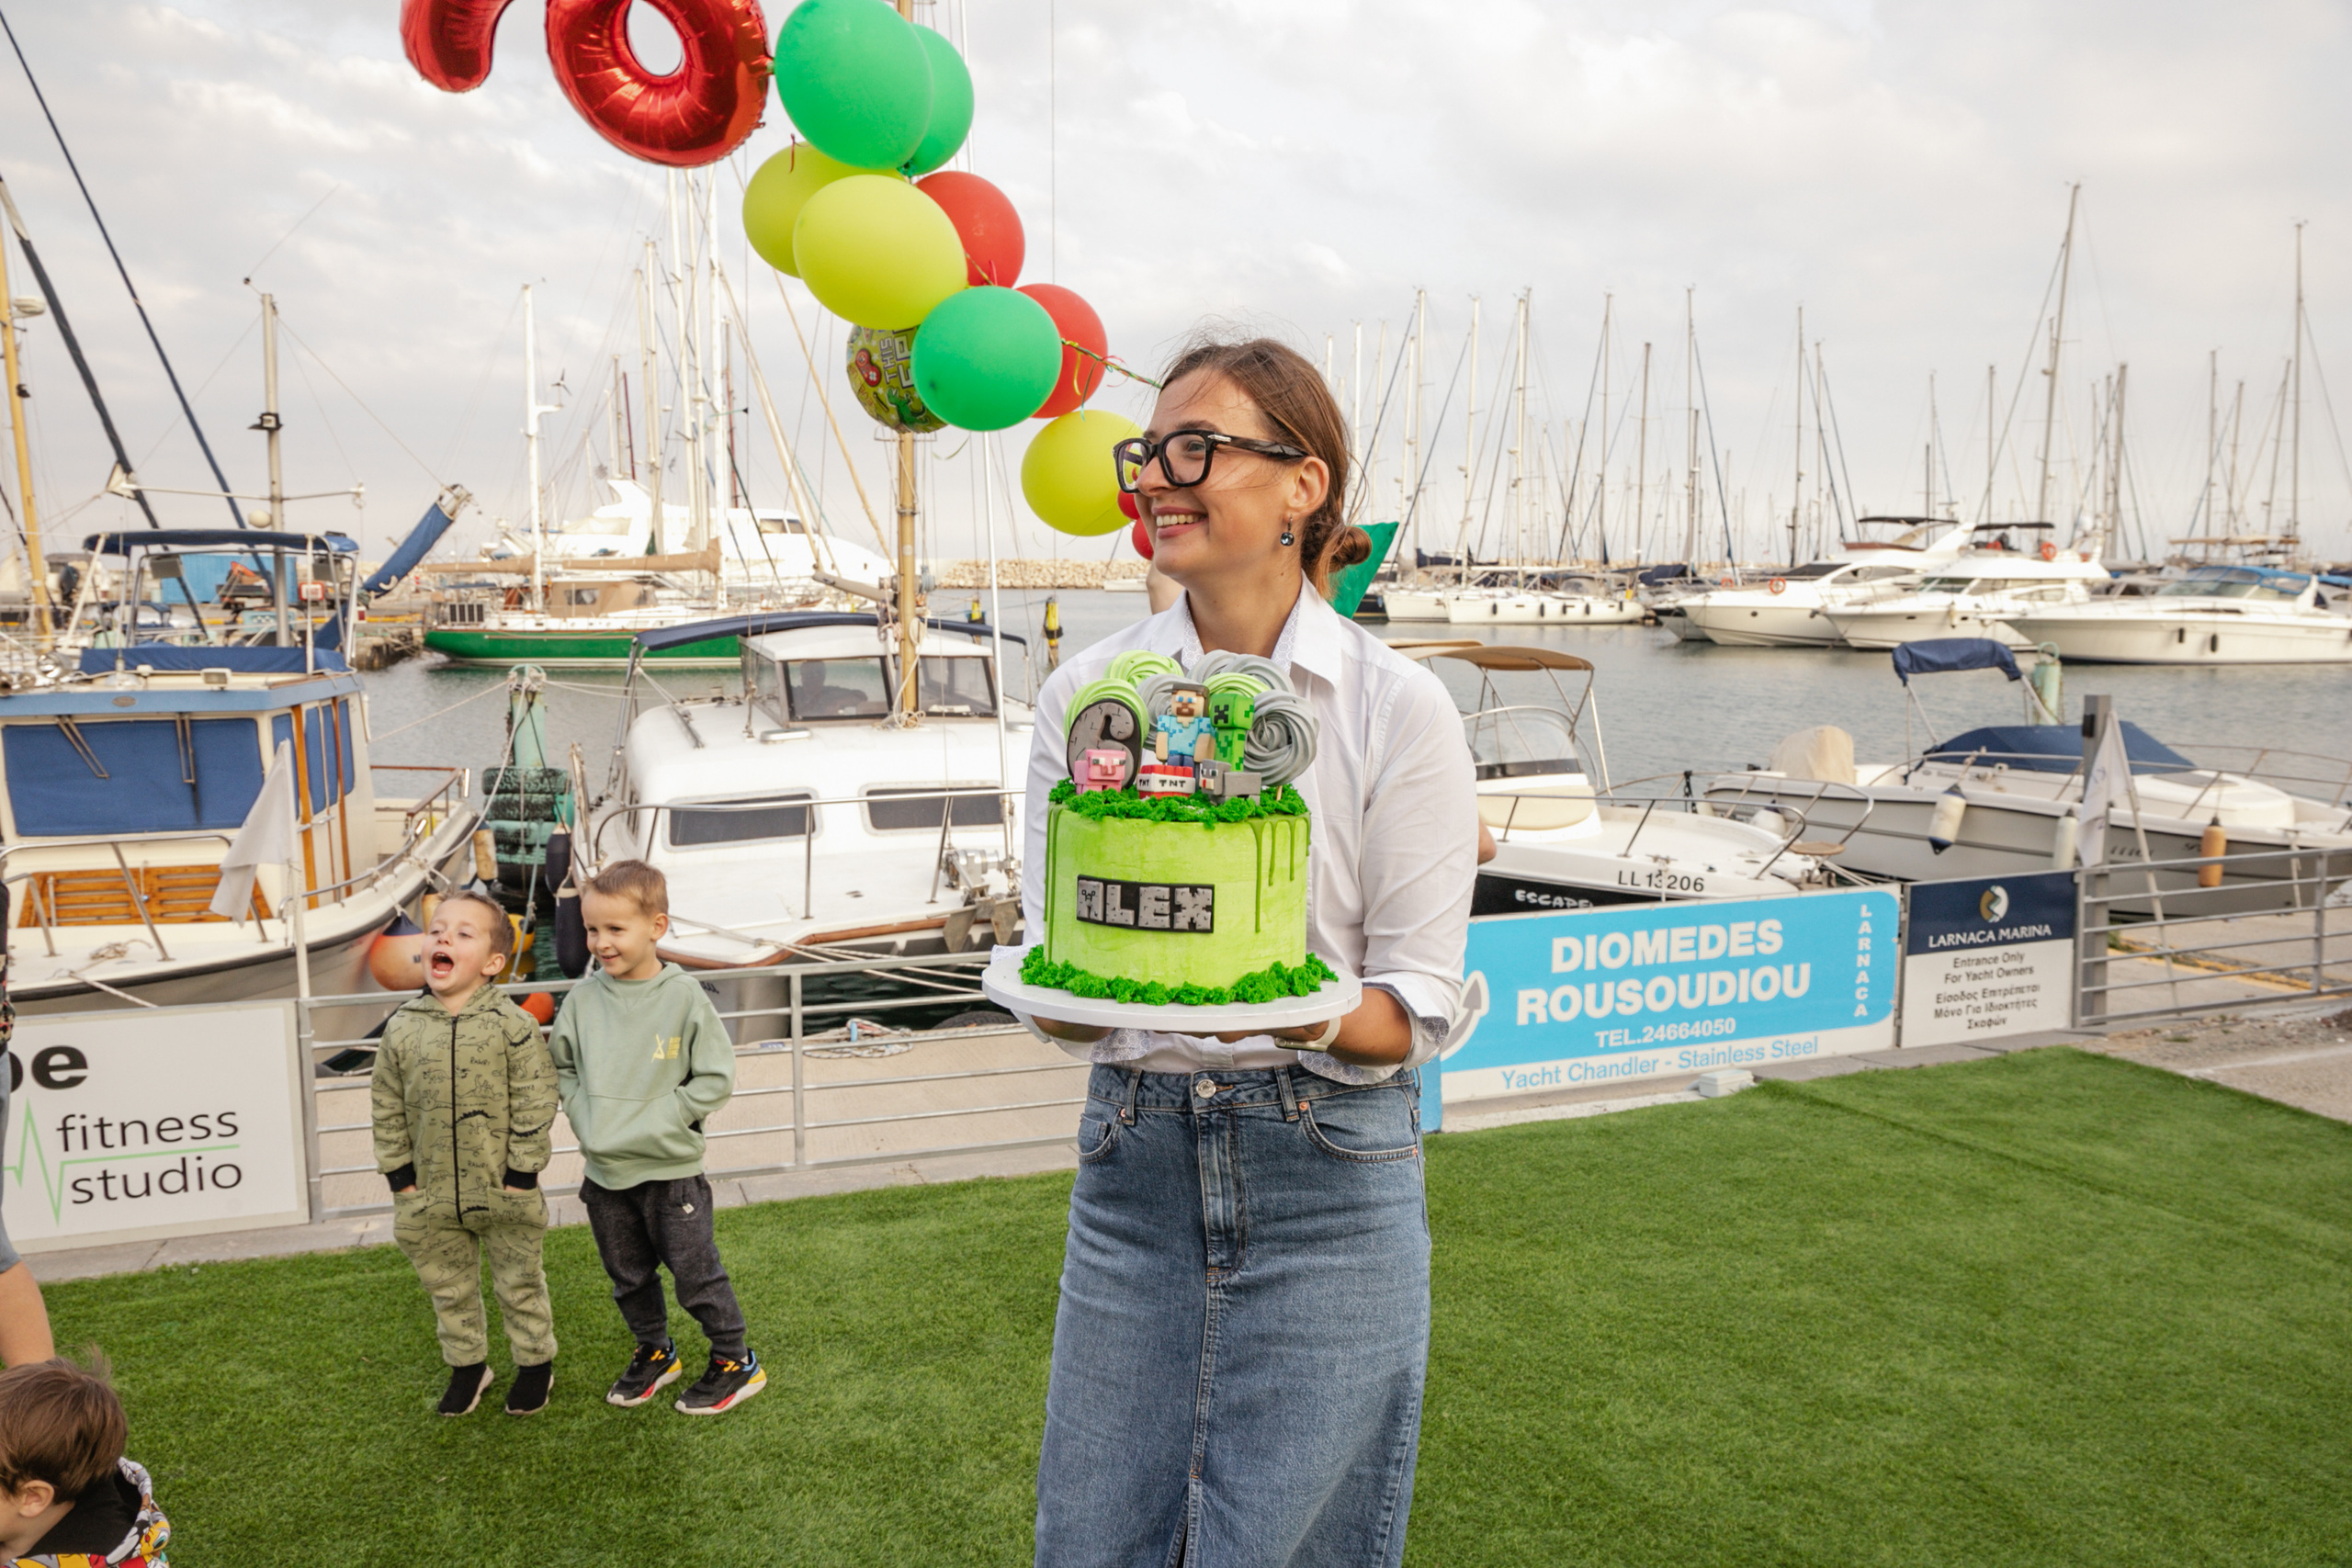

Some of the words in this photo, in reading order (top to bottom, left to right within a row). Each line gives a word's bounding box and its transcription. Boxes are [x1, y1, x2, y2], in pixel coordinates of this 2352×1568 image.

[879, 337, 898, 384] THIS
[1139, 779, 1150, 787] TNT
[1159, 779, 1187, 788] TNT
[1617, 870, 1642, 887] LL
[1077, 878, 1214, 931] ALEX
[1550, 918, 1784, 974] DIOMEDES
[1928, 930, 1996, 949] LARNACA
[1997, 924, 2052, 942] MARINA
[1854, 904, 1871, 1019] LARNACA
[1944, 973, 1962, 984] For
[1965, 968, 1995, 981] Yacht
[1997, 966, 2034, 978] Owners
[1953, 954, 1999, 969] Entrance
[2002, 951, 2026, 964] Only
[1516, 963, 1812, 1026] ROUSOUDIOU
[1934, 1006, 1962, 1020] Μόνο
[1936, 990, 1979, 1005] Είσοδος
[1595, 1017, 1736, 1049] TEL.24664050
[9, 1044, 89, 1093] e
[1501, 1066, 1562, 1090] Yacht
[1567, 1056, 1659, 1083] Chandler
[1678, 1043, 1765, 1069] Stainless
[1770, 1036, 1819, 1060] Steel
[56, 1110, 240, 1153] fitness
[71, 1155, 243, 1206] studio
